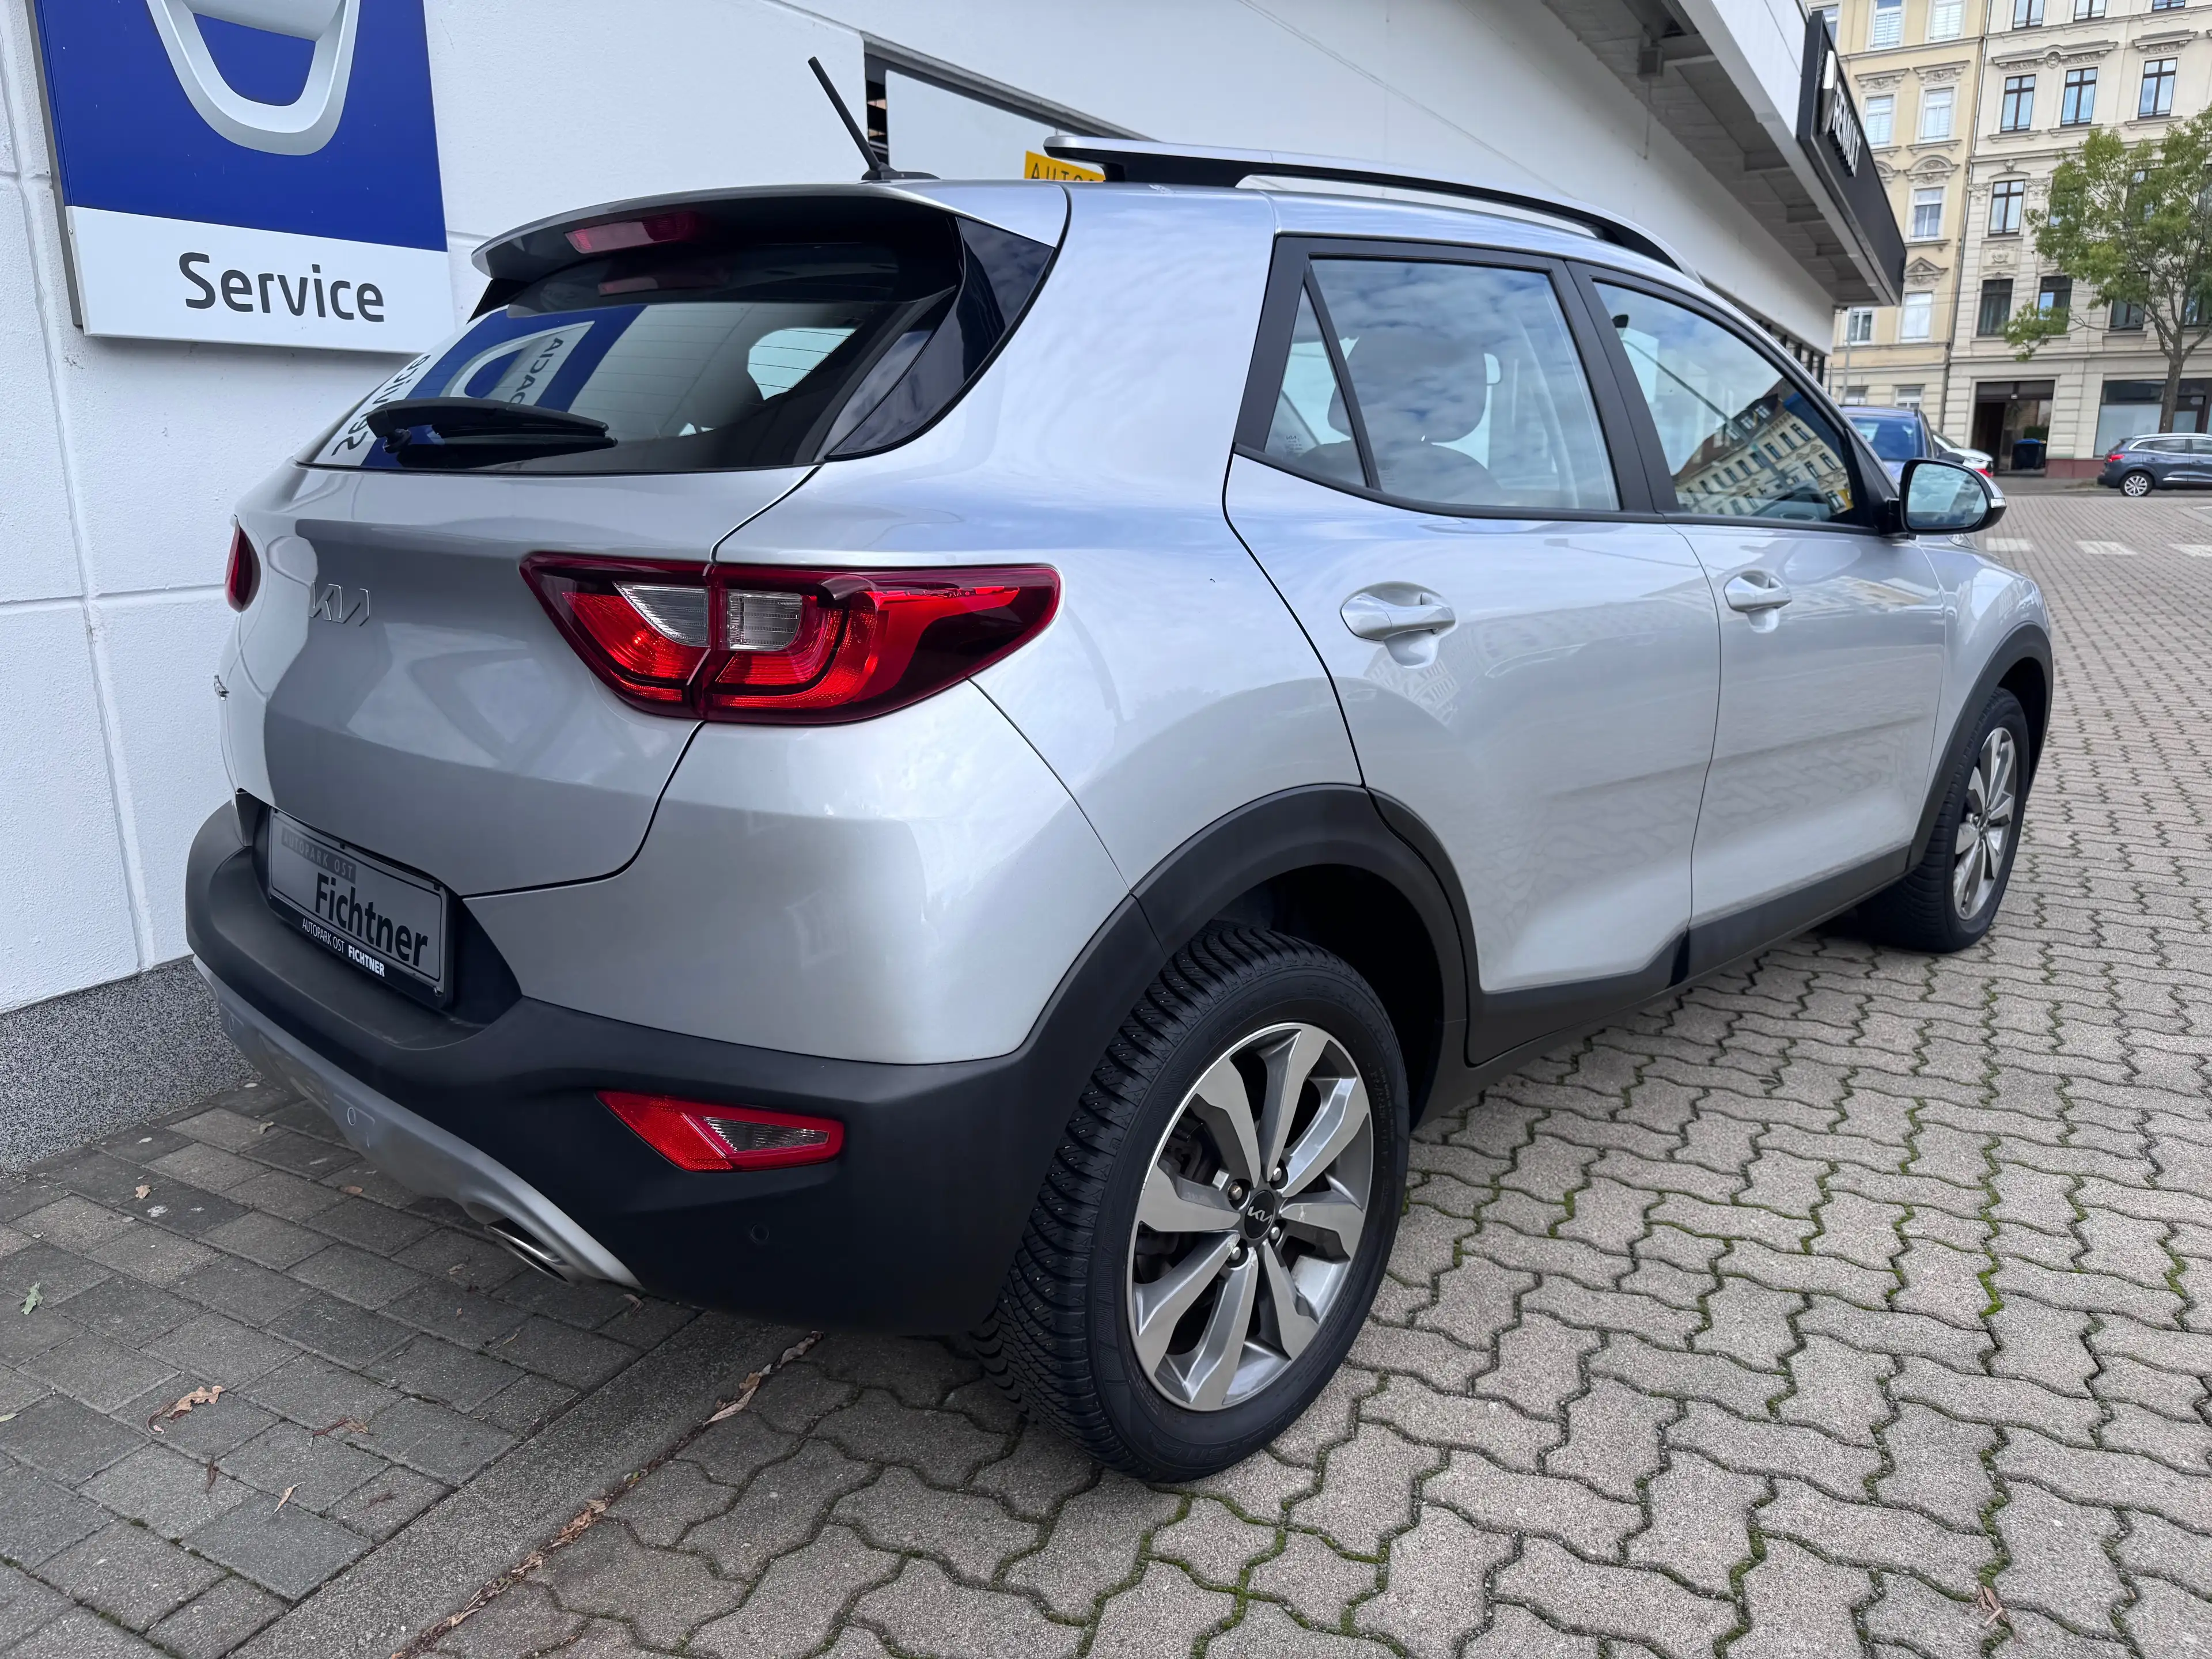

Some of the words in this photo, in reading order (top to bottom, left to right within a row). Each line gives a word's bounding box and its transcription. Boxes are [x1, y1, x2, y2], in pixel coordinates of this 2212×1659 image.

[179, 252, 384, 323] Service
[308, 581, 371, 627] KIA
[283, 832, 329, 868] AUTOPARK
[334, 859, 353, 880] OST
[315, 872, 429, 967] Fichtner
[302, 918, 332, 946] AUTOPARK
[333, 936, 345, 953] OST
[348, 944, 385, 978] FICHTNER
[1247, 1206, 1273, 1224] KIA
